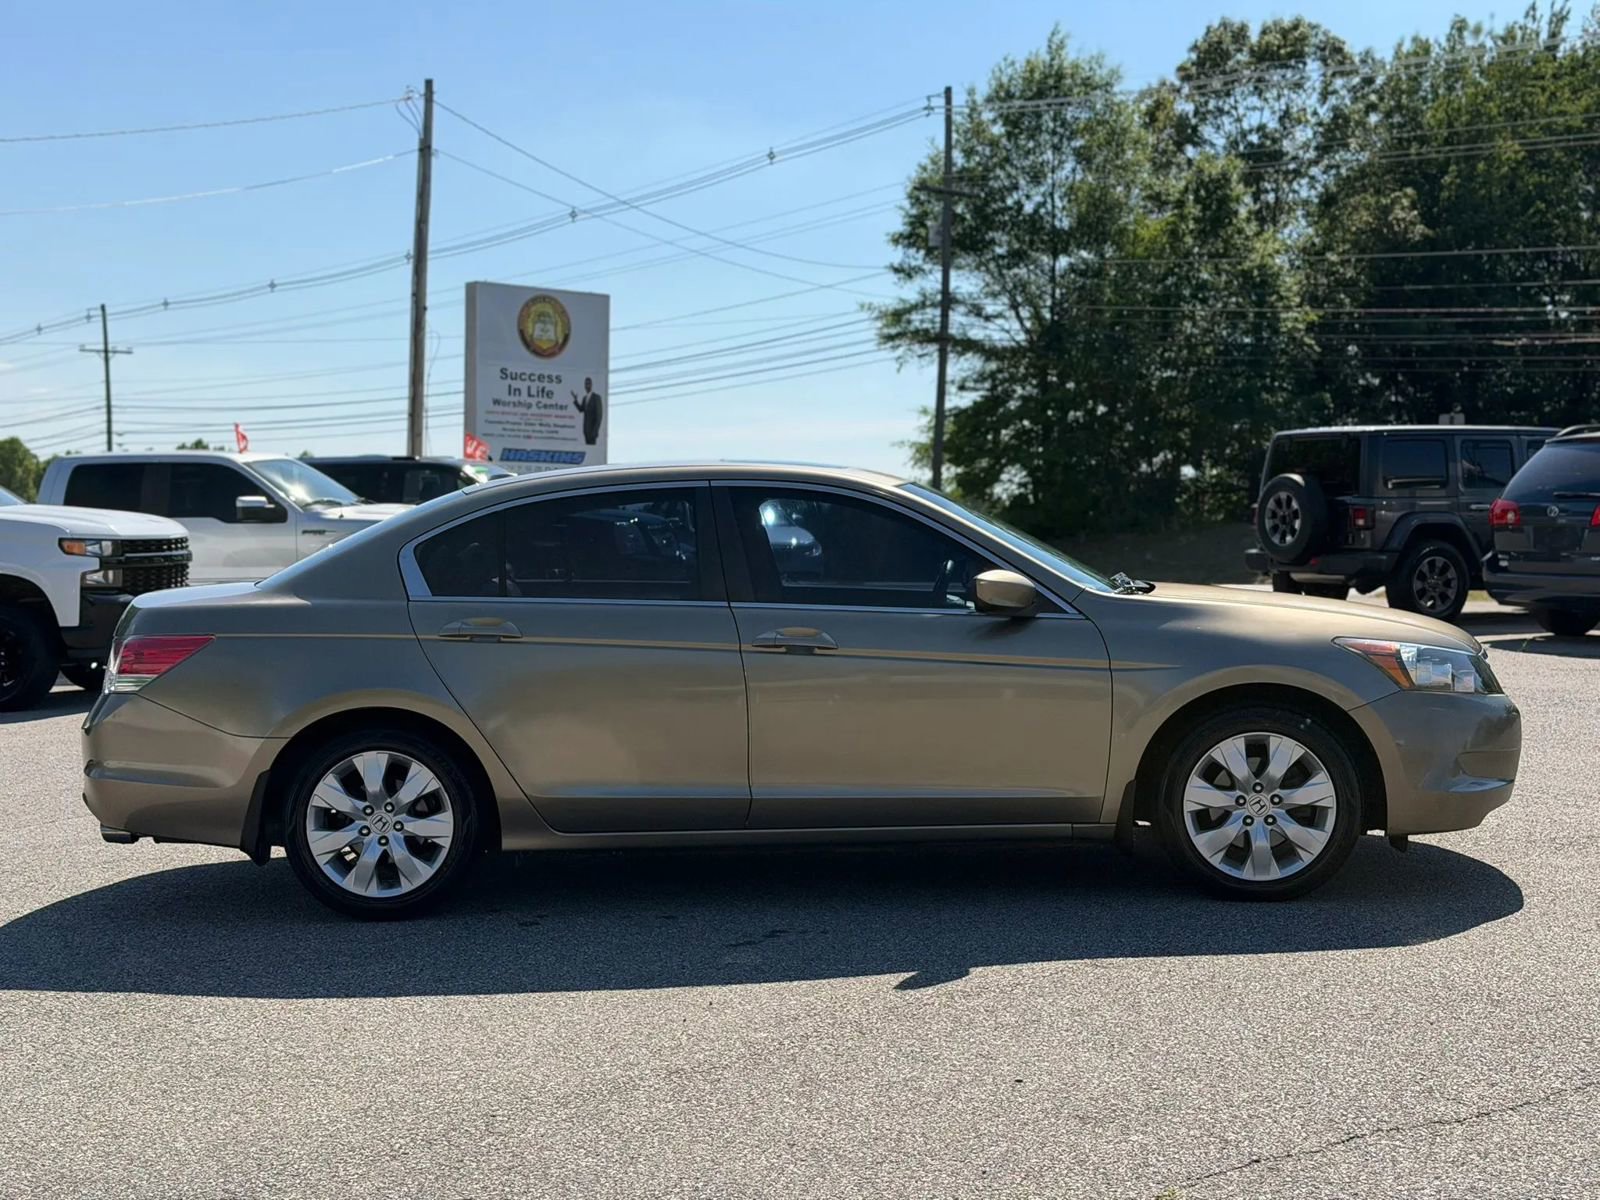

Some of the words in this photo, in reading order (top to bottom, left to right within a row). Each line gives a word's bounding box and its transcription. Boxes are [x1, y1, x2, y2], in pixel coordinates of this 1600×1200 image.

[499, 368, 562, 384] Success
[508, 384, 522, 397] In
[527, 386, 555, 399] Life
[492, 398, 533, 410] Worship
[535, 401, 569, 411] Center
[501, 449, 584, 463] HASKINS
